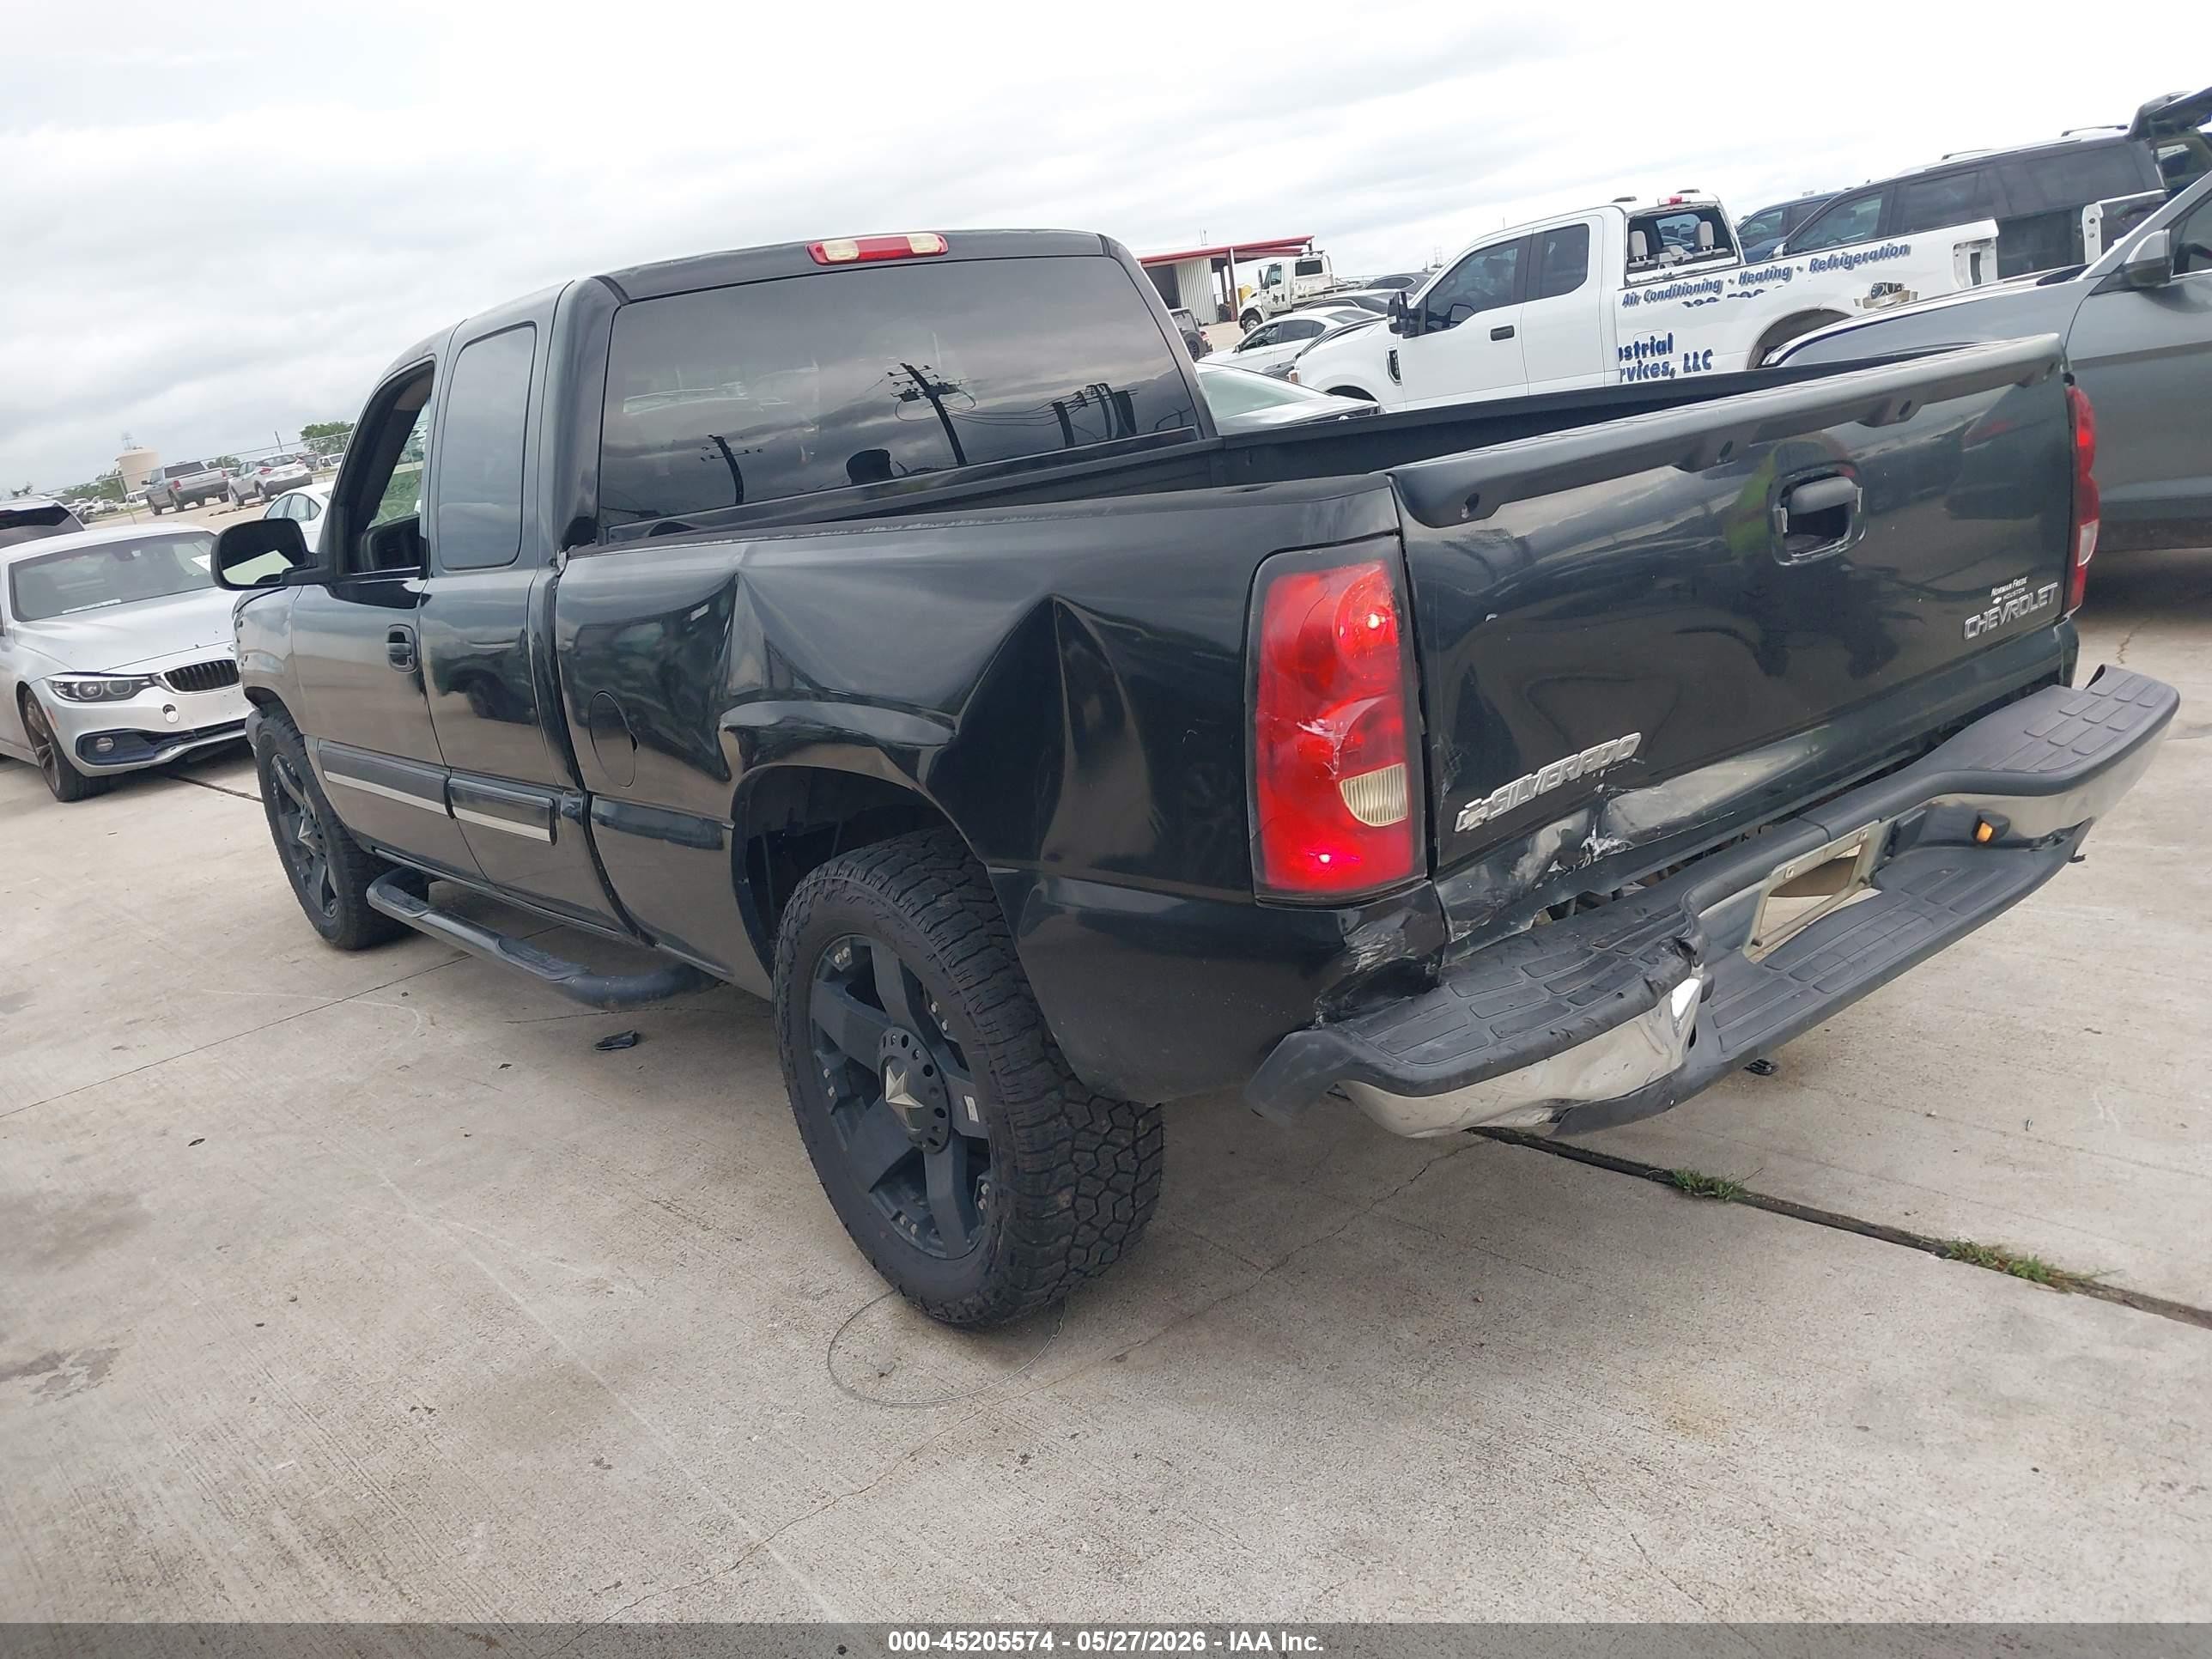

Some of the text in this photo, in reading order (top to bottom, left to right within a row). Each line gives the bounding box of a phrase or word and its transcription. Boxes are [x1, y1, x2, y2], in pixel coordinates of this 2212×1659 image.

[1621, 291, 1641, 308] Air
[1644, 277, 1723, 304] Conditioning
[1738, 264, 1793, 287] Heating
[1808, 242, 1911, 274] Refrigeration
[1683, 349, 1714, 374] LLC
[1964, 581, 2058, 640] CHEVROLET
[1488, 731, 1642, 821] SILVERADO
